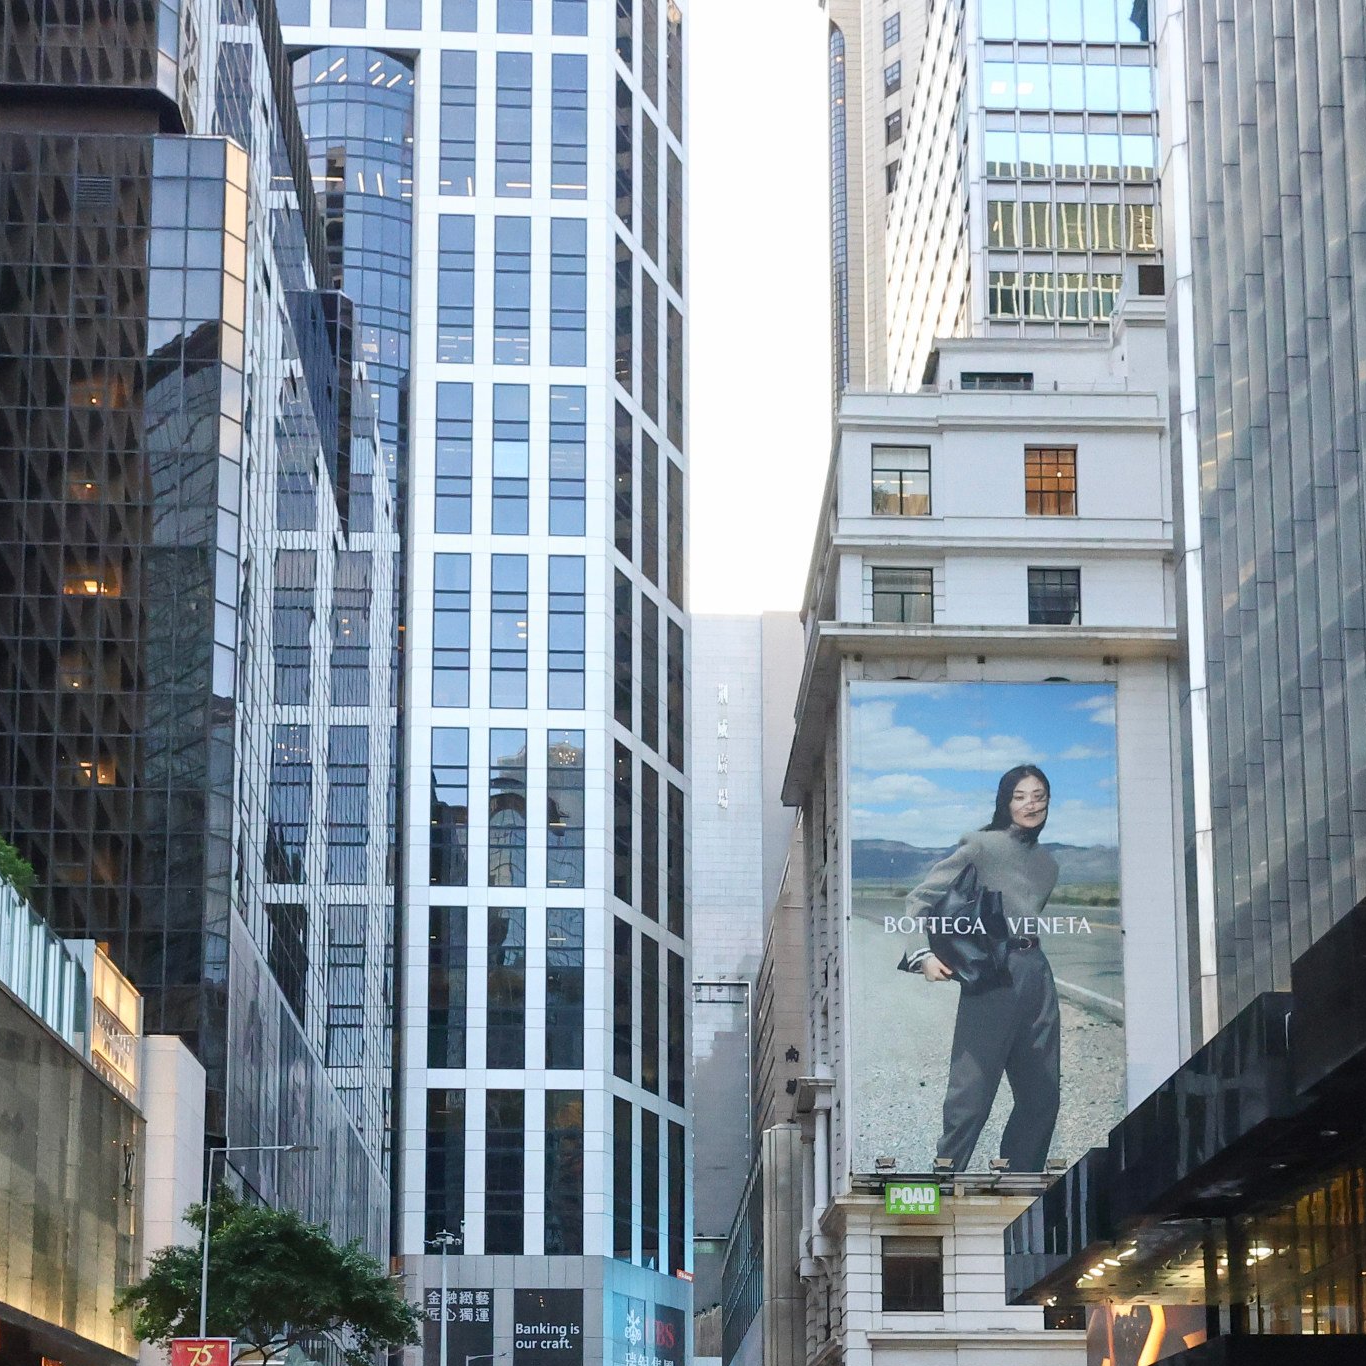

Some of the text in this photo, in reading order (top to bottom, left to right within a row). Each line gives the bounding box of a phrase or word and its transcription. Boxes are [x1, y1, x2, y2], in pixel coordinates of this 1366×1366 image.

[884, 915, 1092, 935] BOTTEGA VENETA
[890, 1186, 936, 1204] POAD
[515, 1323, 580, 1337] Banking is
[515, 1337, 574, 1350] our craft.
